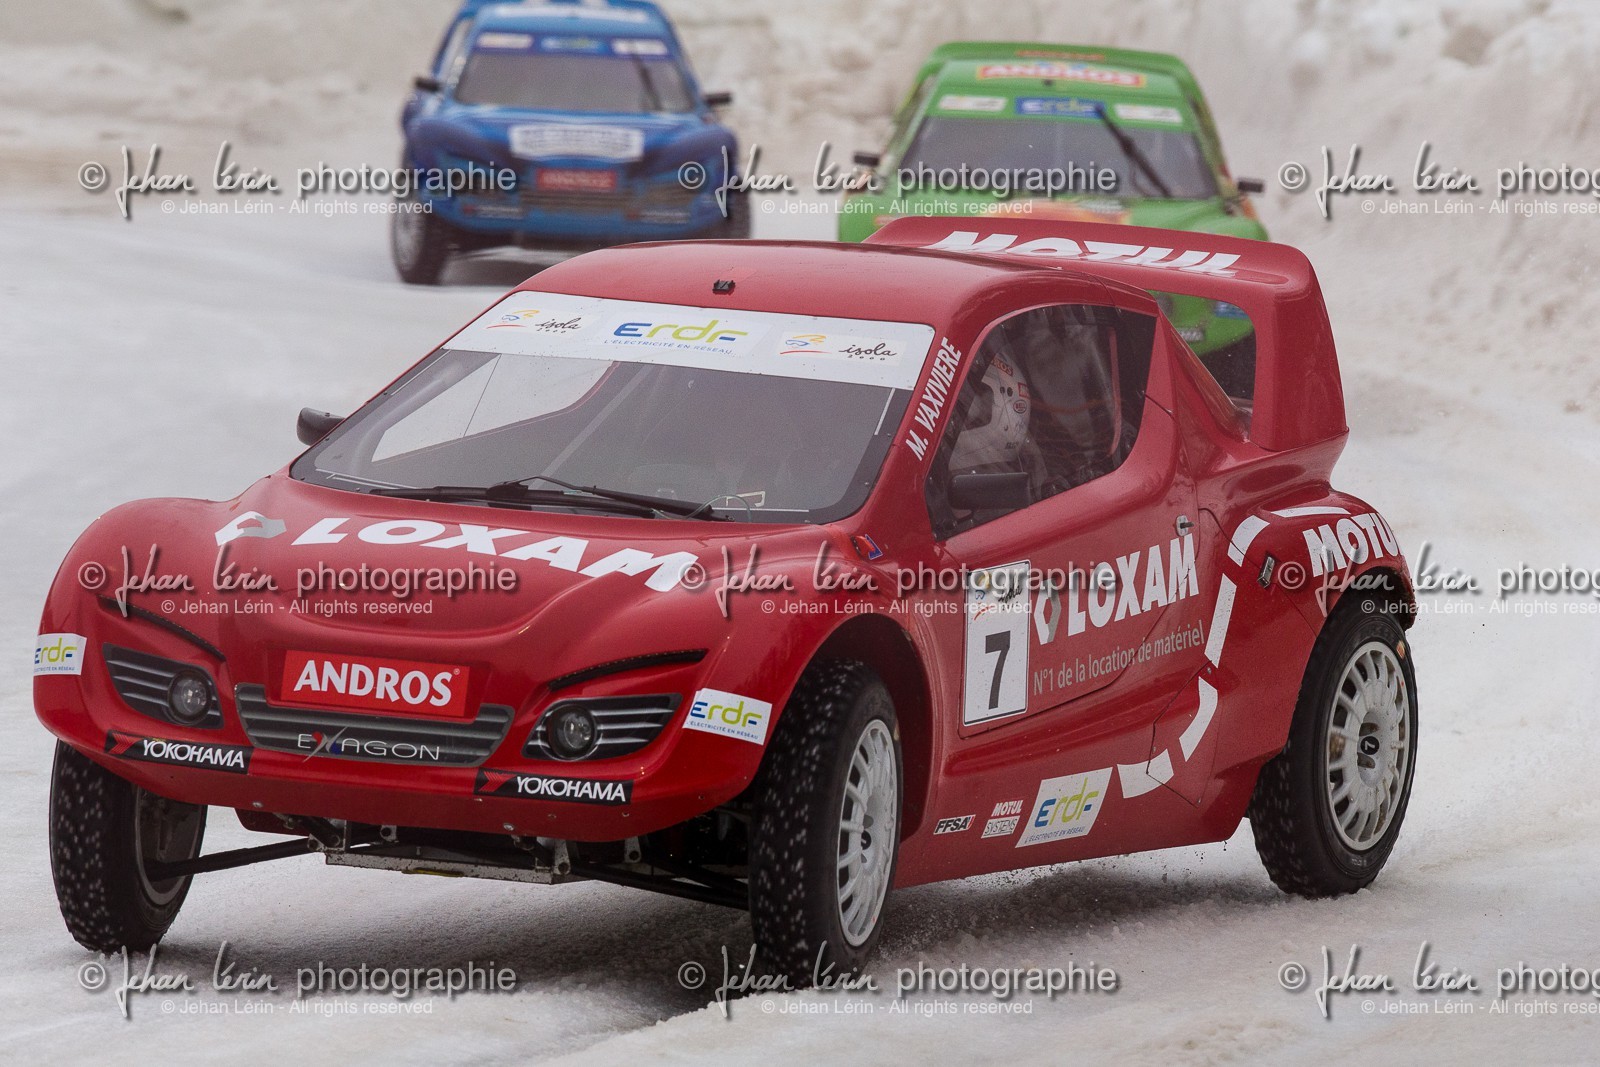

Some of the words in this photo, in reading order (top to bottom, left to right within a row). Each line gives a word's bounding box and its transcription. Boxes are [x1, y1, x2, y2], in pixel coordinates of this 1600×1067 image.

[923, 231, 1241, 277] MOTUL
[838, 343, 897, 356] isola
[914, 337, 962, 433] VAXIVIERE
[905, 430, 929, 461] M.
[291, 517, 698, 592] LOXAM
[1067, 533, 1199, 636] LOXAM
[985, 630, 1011, 710] 7
[1058, 662, 1072, 688] de
[1075, 658, 1085, 683] la
[1088, 646, 1135, 679] location
[1138, 637, 1151, 663] de
[1154, 619, 1205, 657] matériel
[143, 739, 245, 768] YOKOHAMA
[516, 776, 626, 802] YOKOHAMA
[935, 817, 970, 833] FFSA
[991, 800, 1023, 817] MOTUL
